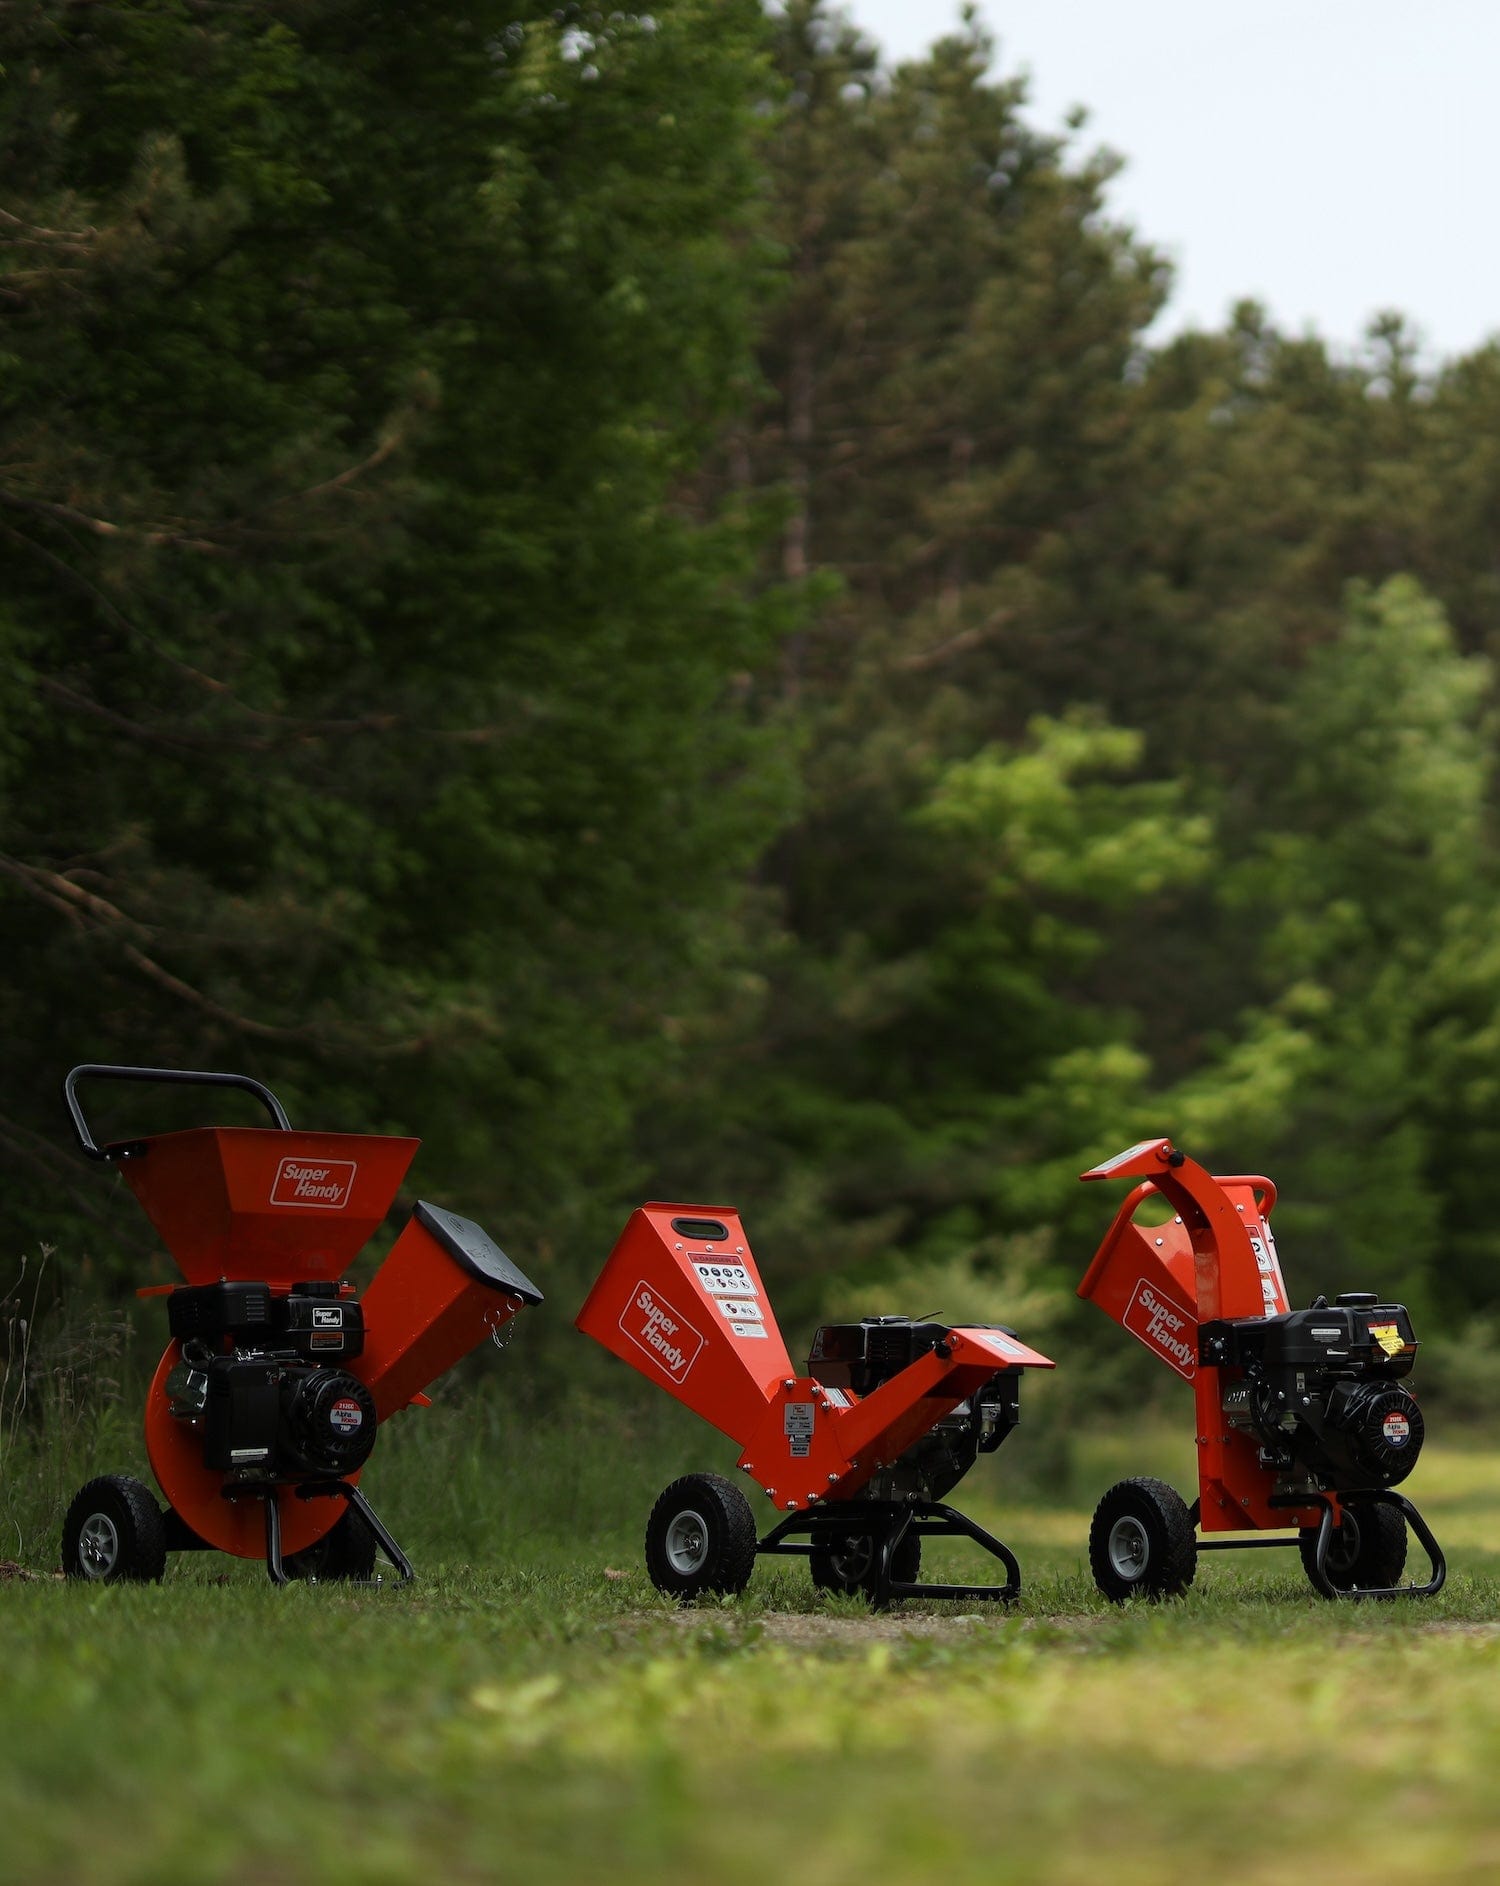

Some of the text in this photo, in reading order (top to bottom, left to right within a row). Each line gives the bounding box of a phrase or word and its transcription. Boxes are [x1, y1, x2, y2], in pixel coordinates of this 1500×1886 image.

[283, 1163, 330, 1183] Super
[294, 1181, 345, 1202] Handy
[315, 1310, 332, 1318] Super
[321, 1316, 340, 1325] Handy
[637, 1291, 679, 1336] Super
[1139, 1289, 1185, 1333] Super
[640, 1318, 687, 1371] Handy
[1145, 1314, 1195, 1367] Handy
